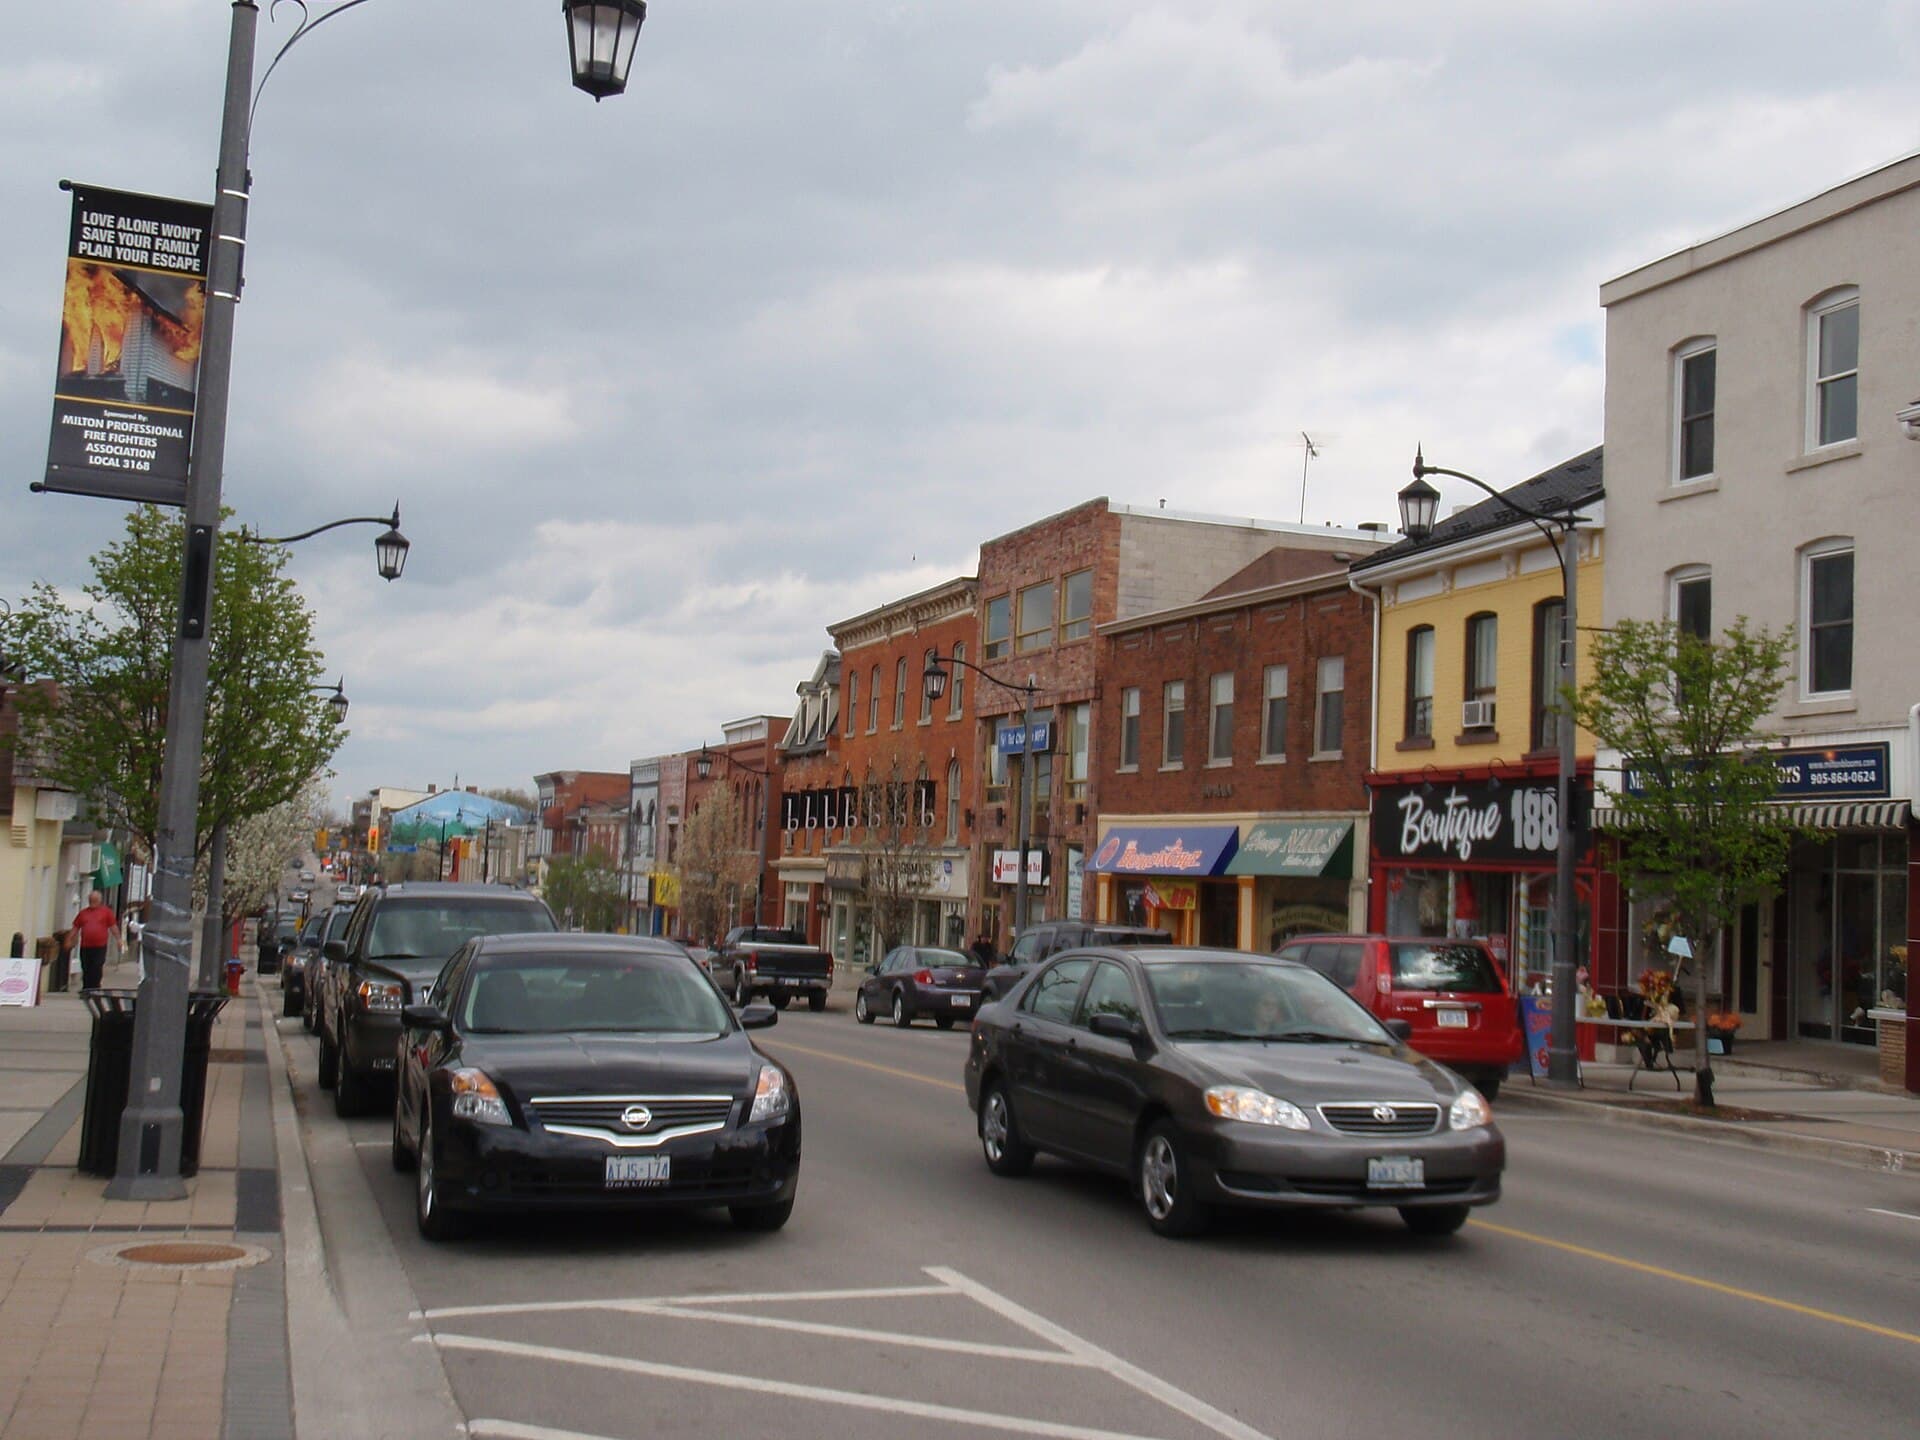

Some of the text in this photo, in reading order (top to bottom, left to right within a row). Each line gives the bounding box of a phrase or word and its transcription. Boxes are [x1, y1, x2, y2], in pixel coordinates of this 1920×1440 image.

[82, 211, 202, 241] LOVE ALONE WON'T
[82, 227, 200, 256] SAVE YOUR FAMILY
[78, 241, 201, 272] PLAN YOUR ESCAPE
[62, 414, 184, 438] MILTON PROFESSIONAL
[83, 430, 158, 447] FIRE FIGHTERS
[85, 443, 156, 459] ASSOCIATION
[89, 455, 151, 471] LOCAL 3168
[1810, 770, 1876, 785] 905-864-0624
[1398, 786, 1501, 861] Boutique
